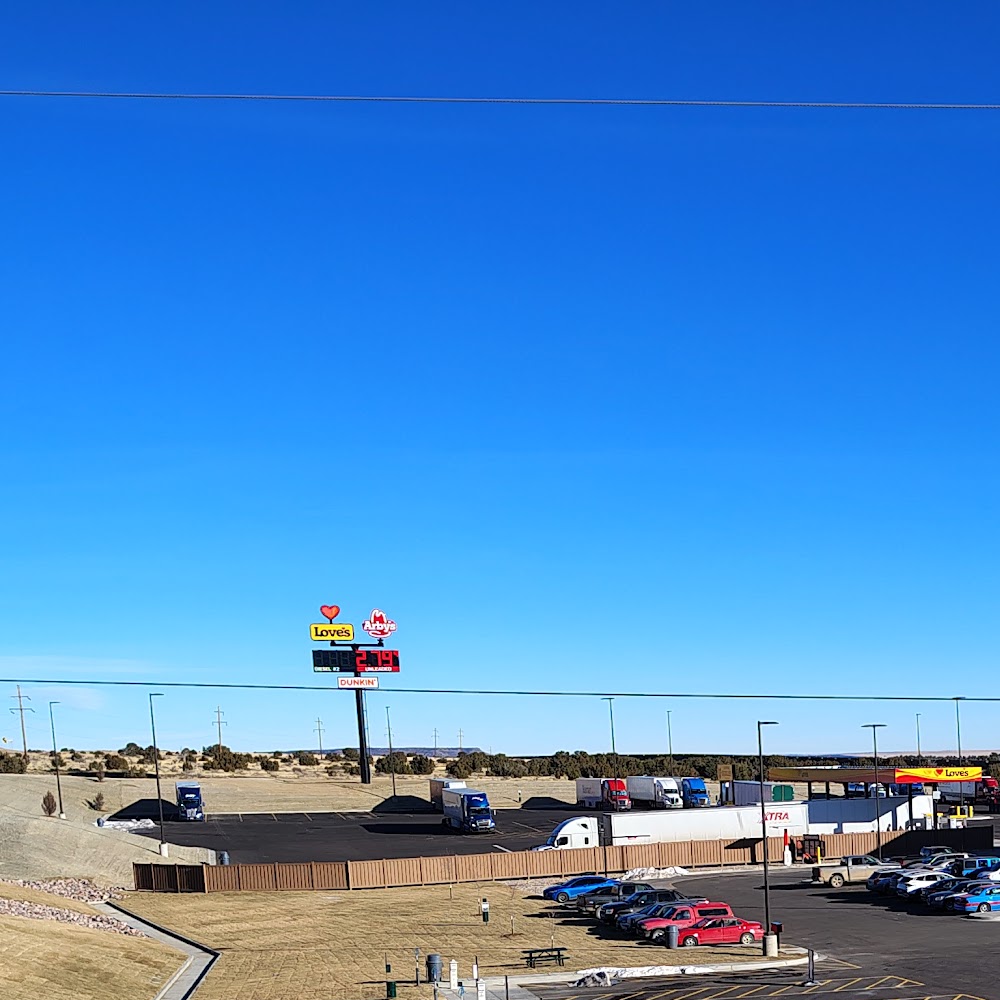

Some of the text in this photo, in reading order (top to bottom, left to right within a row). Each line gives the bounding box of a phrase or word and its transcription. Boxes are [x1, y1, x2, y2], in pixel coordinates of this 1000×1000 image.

[314, 626, 351, 637] Love's
[363, 621, 396, 632] Arby's
[945, 768, 969, 777] Love's
